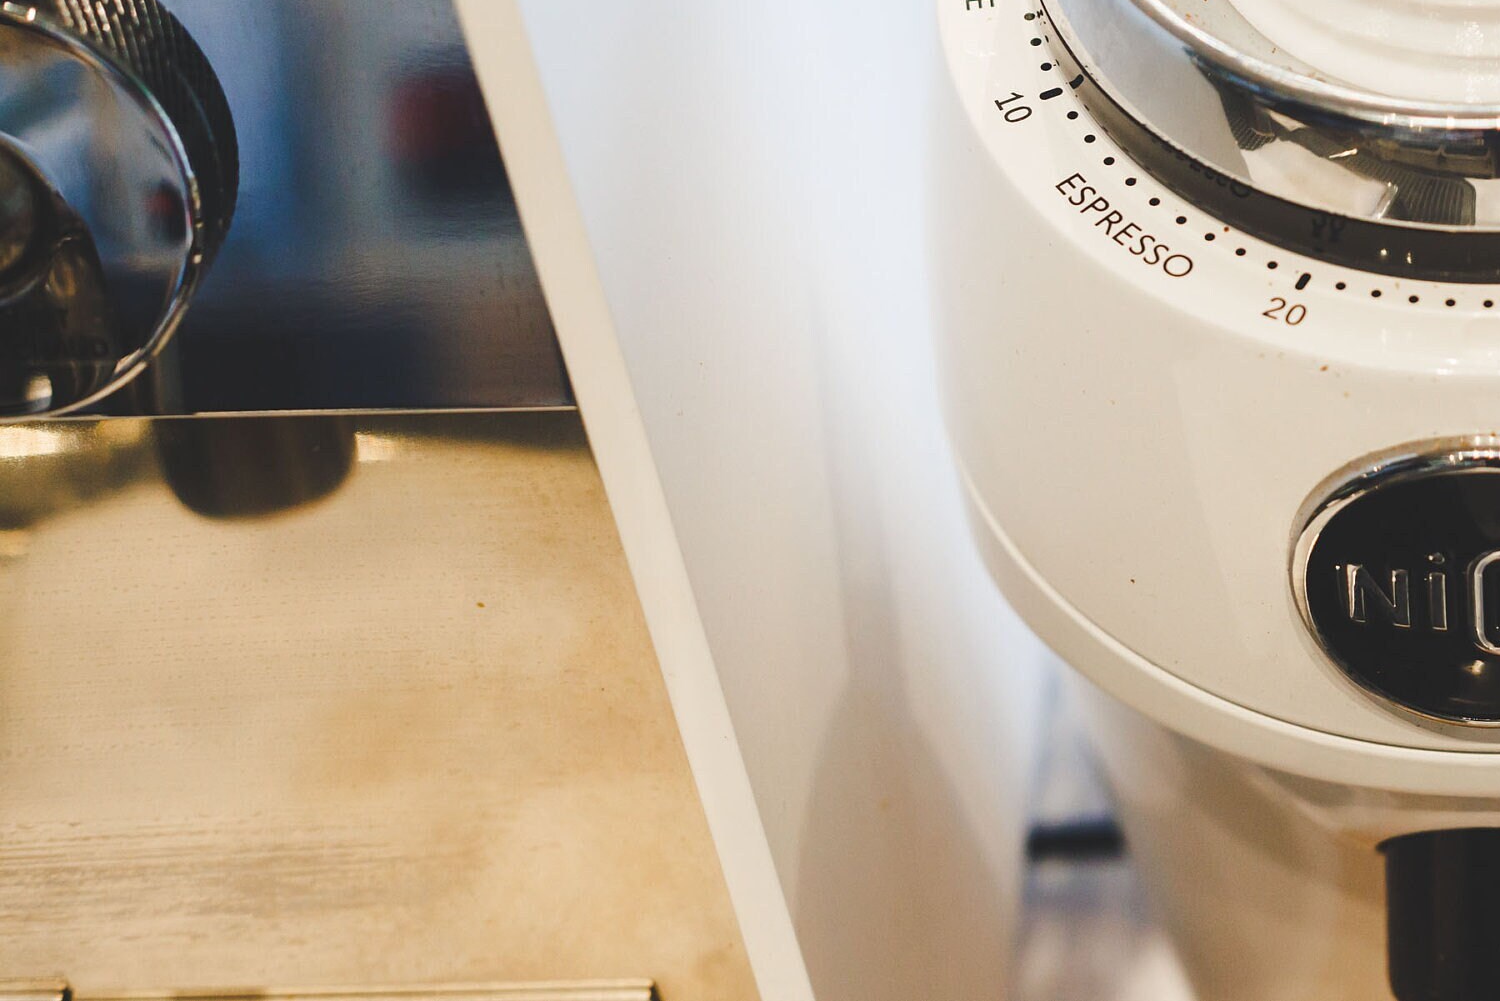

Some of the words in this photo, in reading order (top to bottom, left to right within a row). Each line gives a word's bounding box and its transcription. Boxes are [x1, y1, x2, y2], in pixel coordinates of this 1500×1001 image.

[993, 91, 1033, 124] 10
[1054, 172, 1194, 279] ESPRESSO
[1261, 296, 1308, 326] 20
